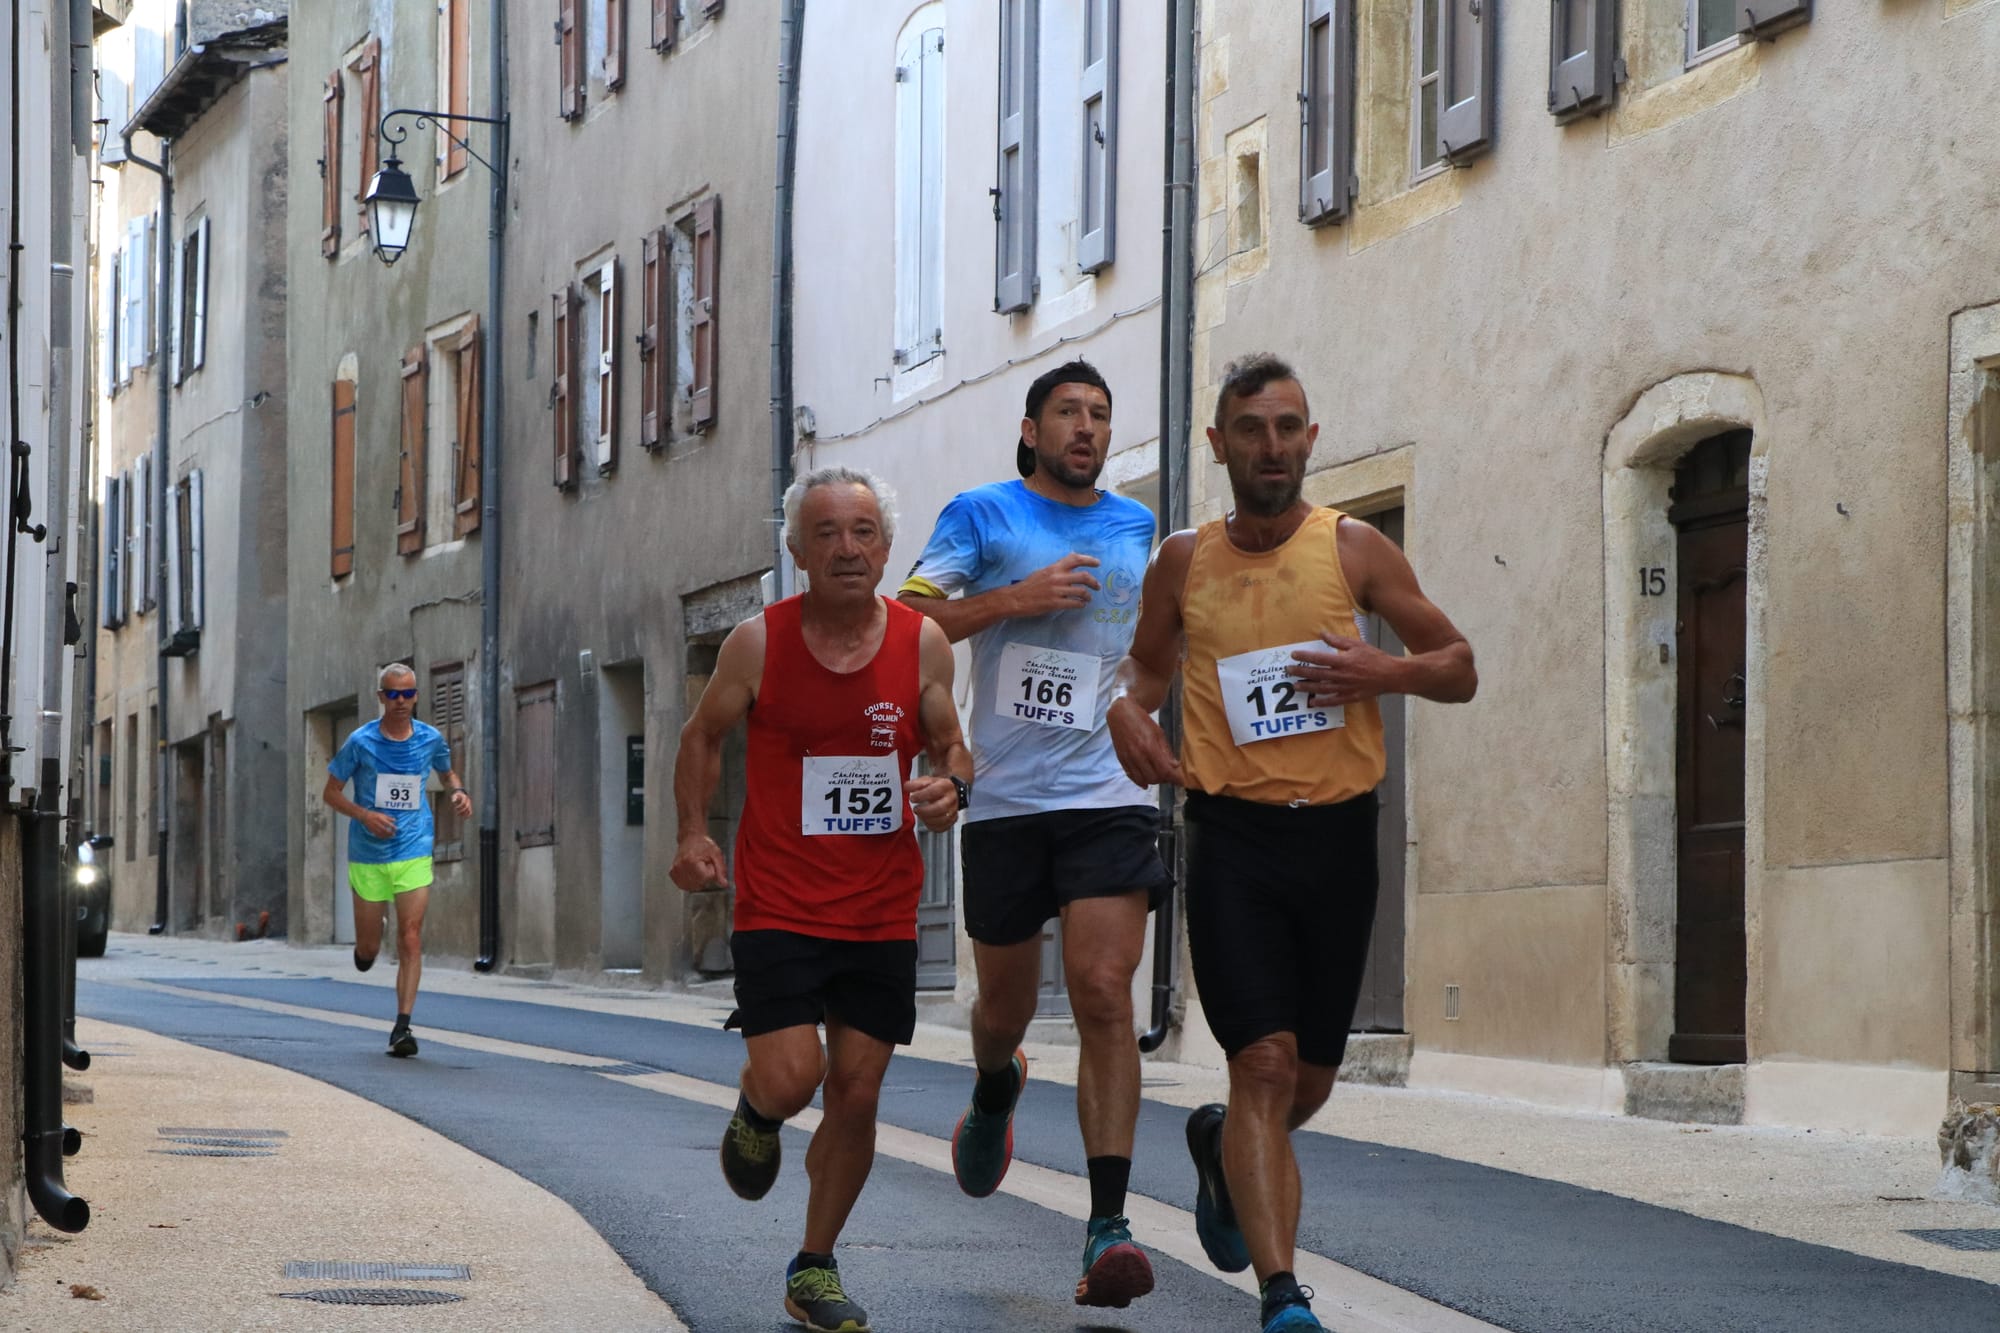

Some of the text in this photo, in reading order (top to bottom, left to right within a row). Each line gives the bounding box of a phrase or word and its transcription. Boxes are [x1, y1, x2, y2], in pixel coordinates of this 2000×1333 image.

[1638, 567, 1666, 596] 15
[1250, 665, 1288, 677] Challeng
[1021, 676, 1073, 707] 166
[864, 702, 894, 716] COURSE
[1013, 702, 1075, 725] TUFF'S
[872, 713, 898, 722] DOLMEN
[1250, 711, 1327, 737] TUFF'S
[832, 771, 870, 781] Challenge
[390, 788, 410, 801] 93
[824, 787, 893, 815] 152
[824, 817, 892, 832] TUFF'S
